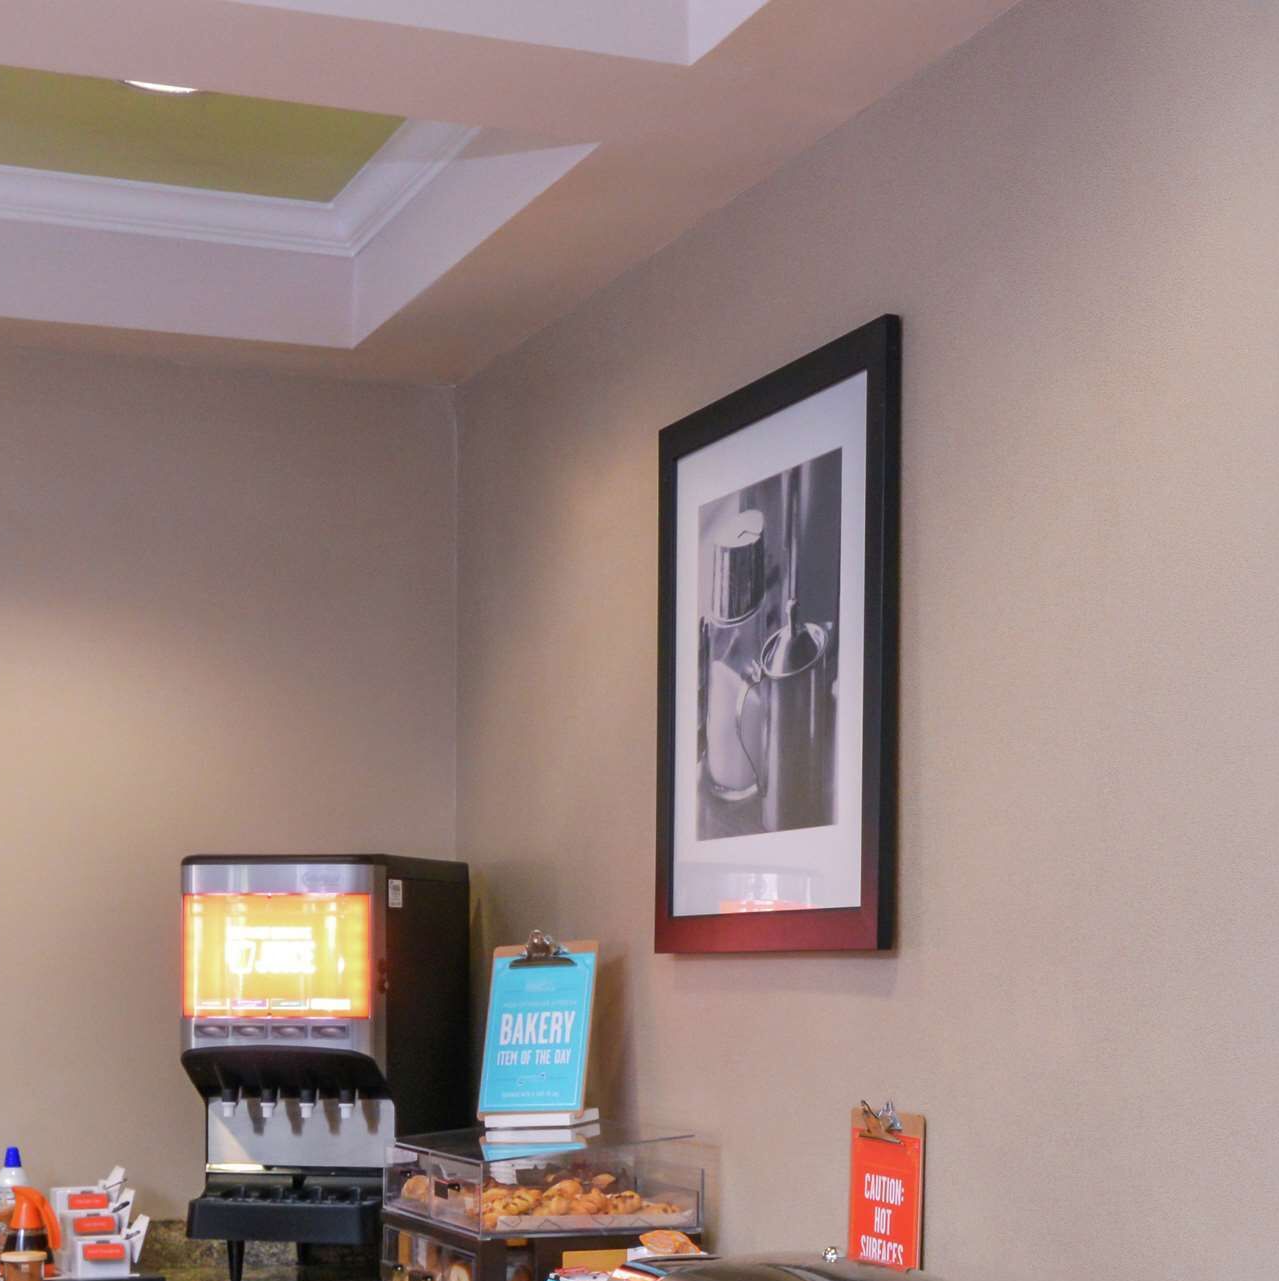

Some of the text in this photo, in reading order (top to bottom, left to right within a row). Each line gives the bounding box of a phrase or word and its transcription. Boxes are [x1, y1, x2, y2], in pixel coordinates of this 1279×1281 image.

[499, 1011, 576, 1045] BAKERY
[497, 1048, 571, 1065] ITEM OF THE DAY
[864, 1173, 905, 1206] CAUTION:
[874, 1206, 892, 1235] HOT
[860, 1234, 903, 1265] SURFACES
